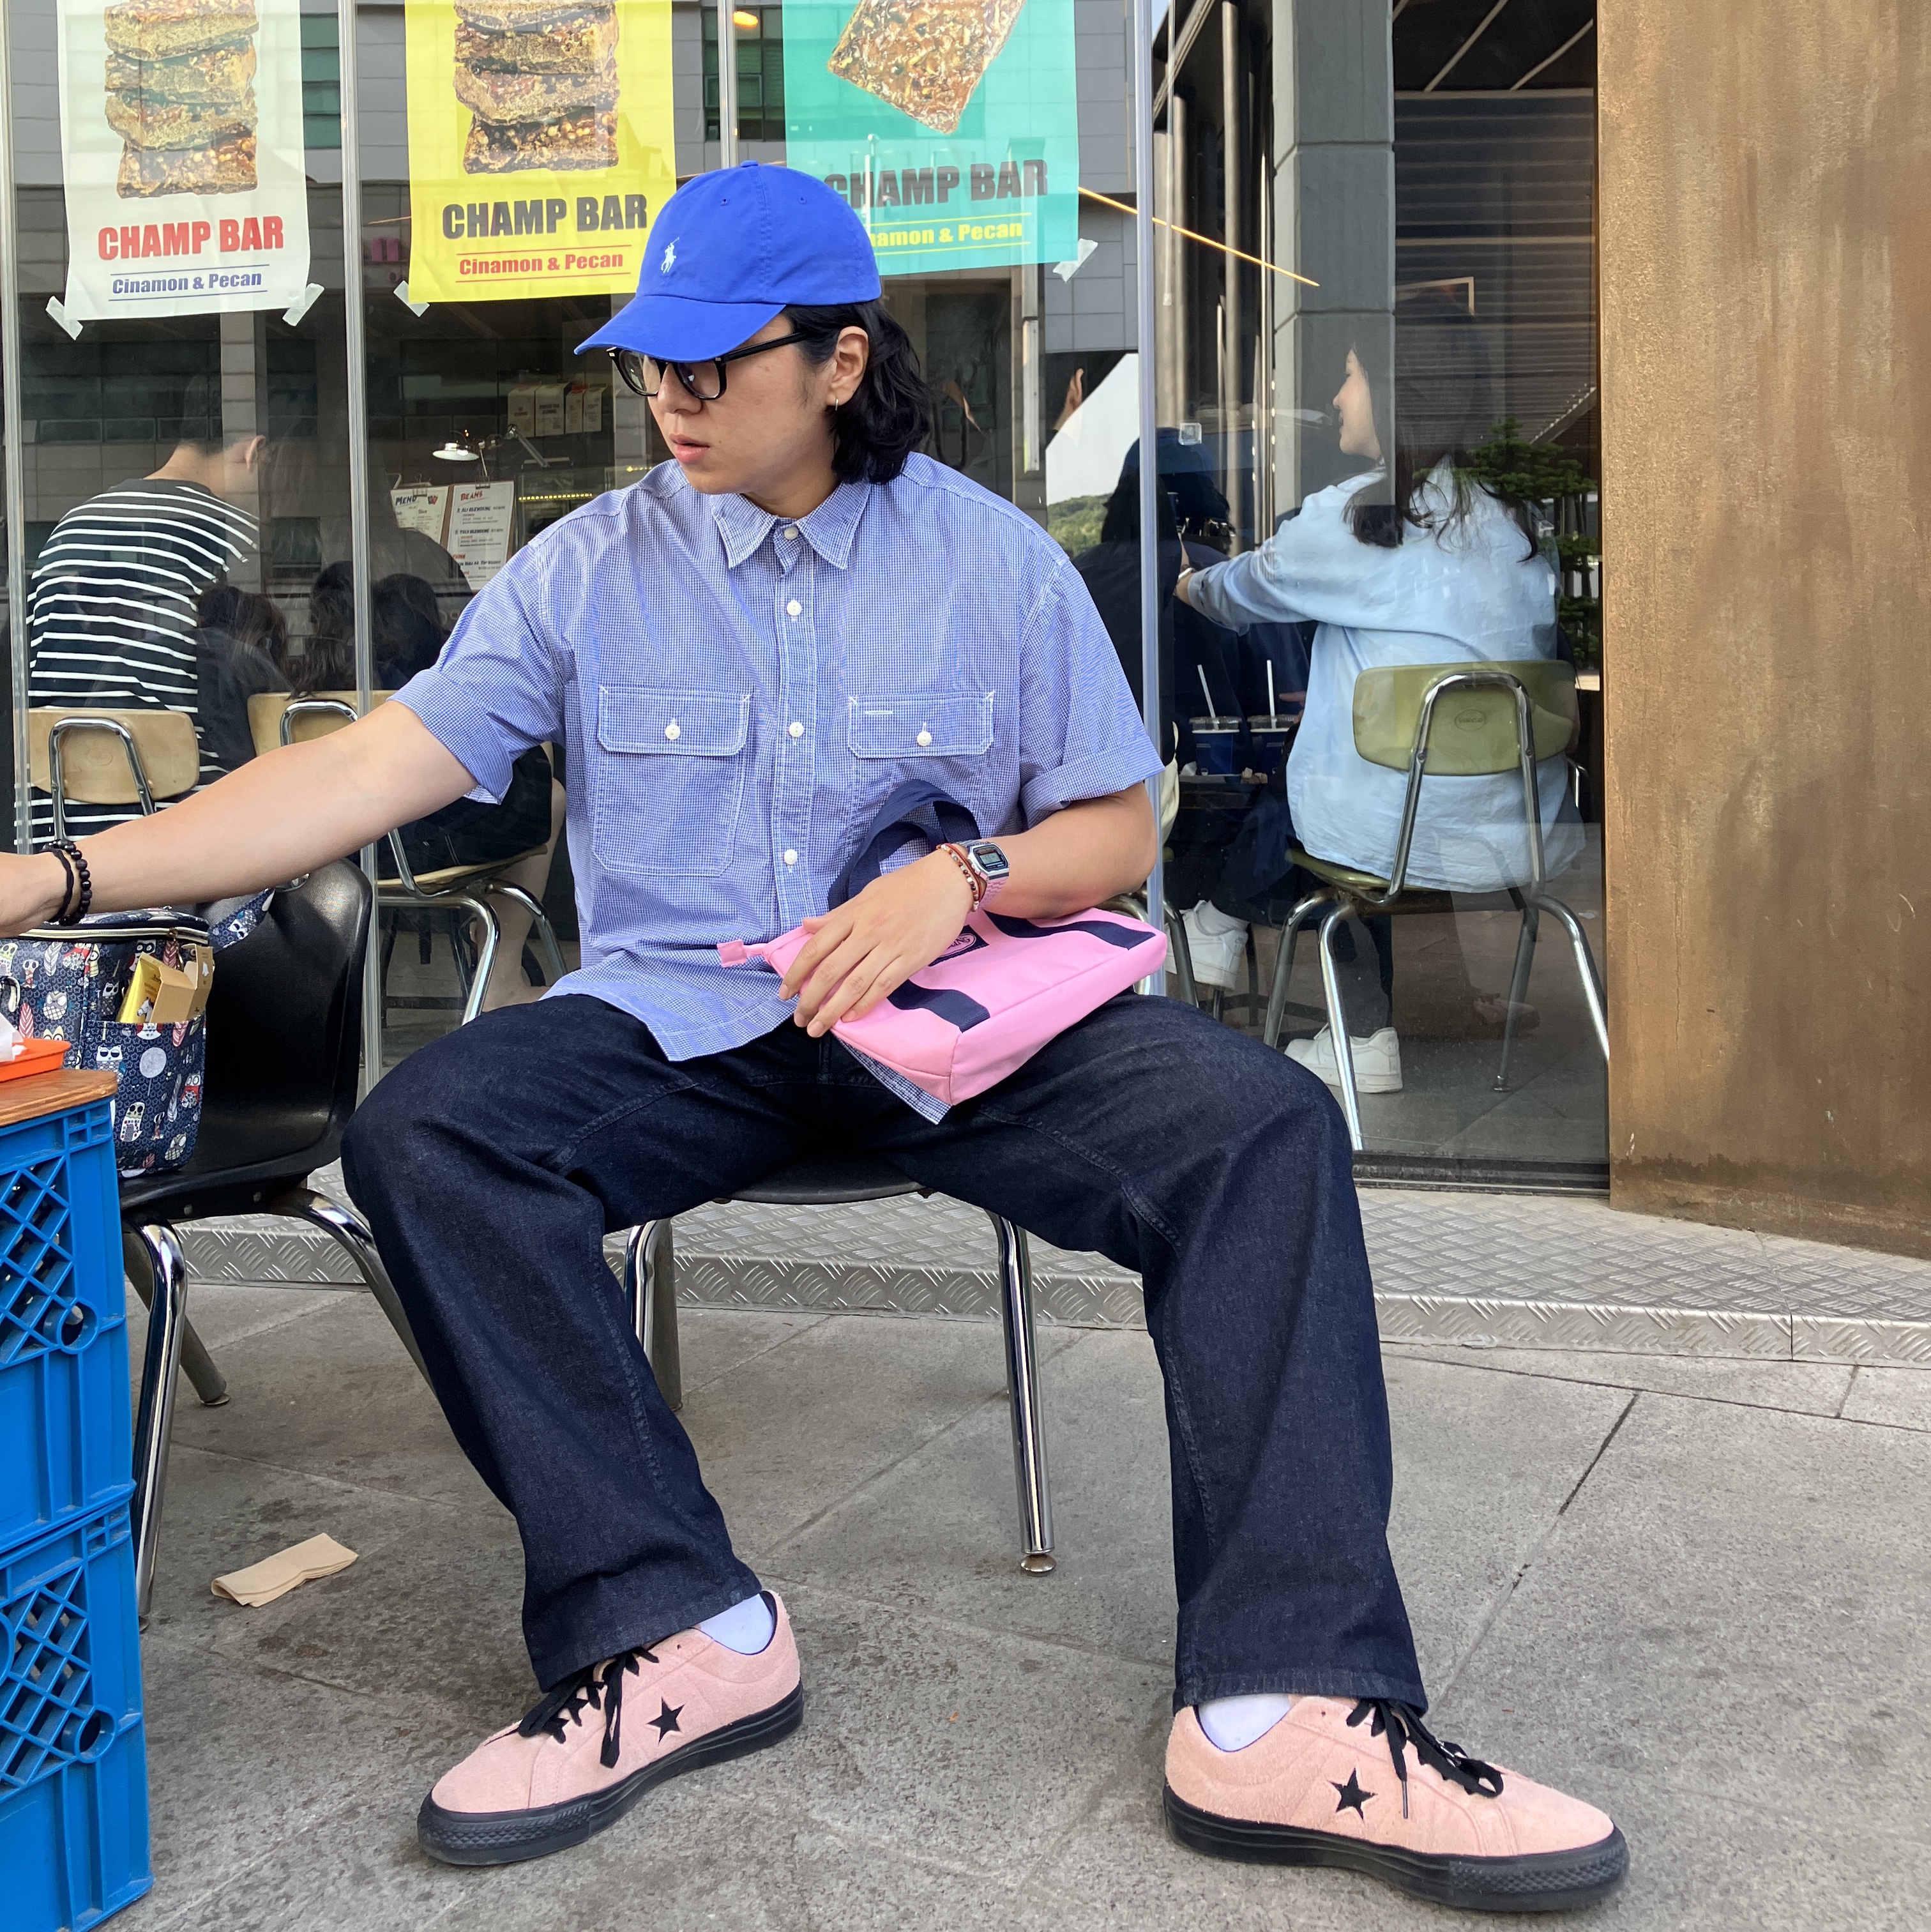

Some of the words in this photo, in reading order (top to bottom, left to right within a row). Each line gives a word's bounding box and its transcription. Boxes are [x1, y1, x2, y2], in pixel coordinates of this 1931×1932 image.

[971, 160, 1048, 201] BAR
[442, 197, 567, 240] CHAMP
[576, 193, 647, 232] BAR
[939, 227, 954, 243] &
[958, 221, 1022, 241] Pecan
[98, 220, 211, 261] CHAMP
[219, 215, 284, 252] BAR
[459, 258, 543, 275] Cinamon
[547, 257, 561, 271] &
[564, 254, 624, 270] Pecan
[112, 277, 188, 294] Cinamon
[192, 276, 205, 290] &
[208, 272, 262, 289] Pecan
